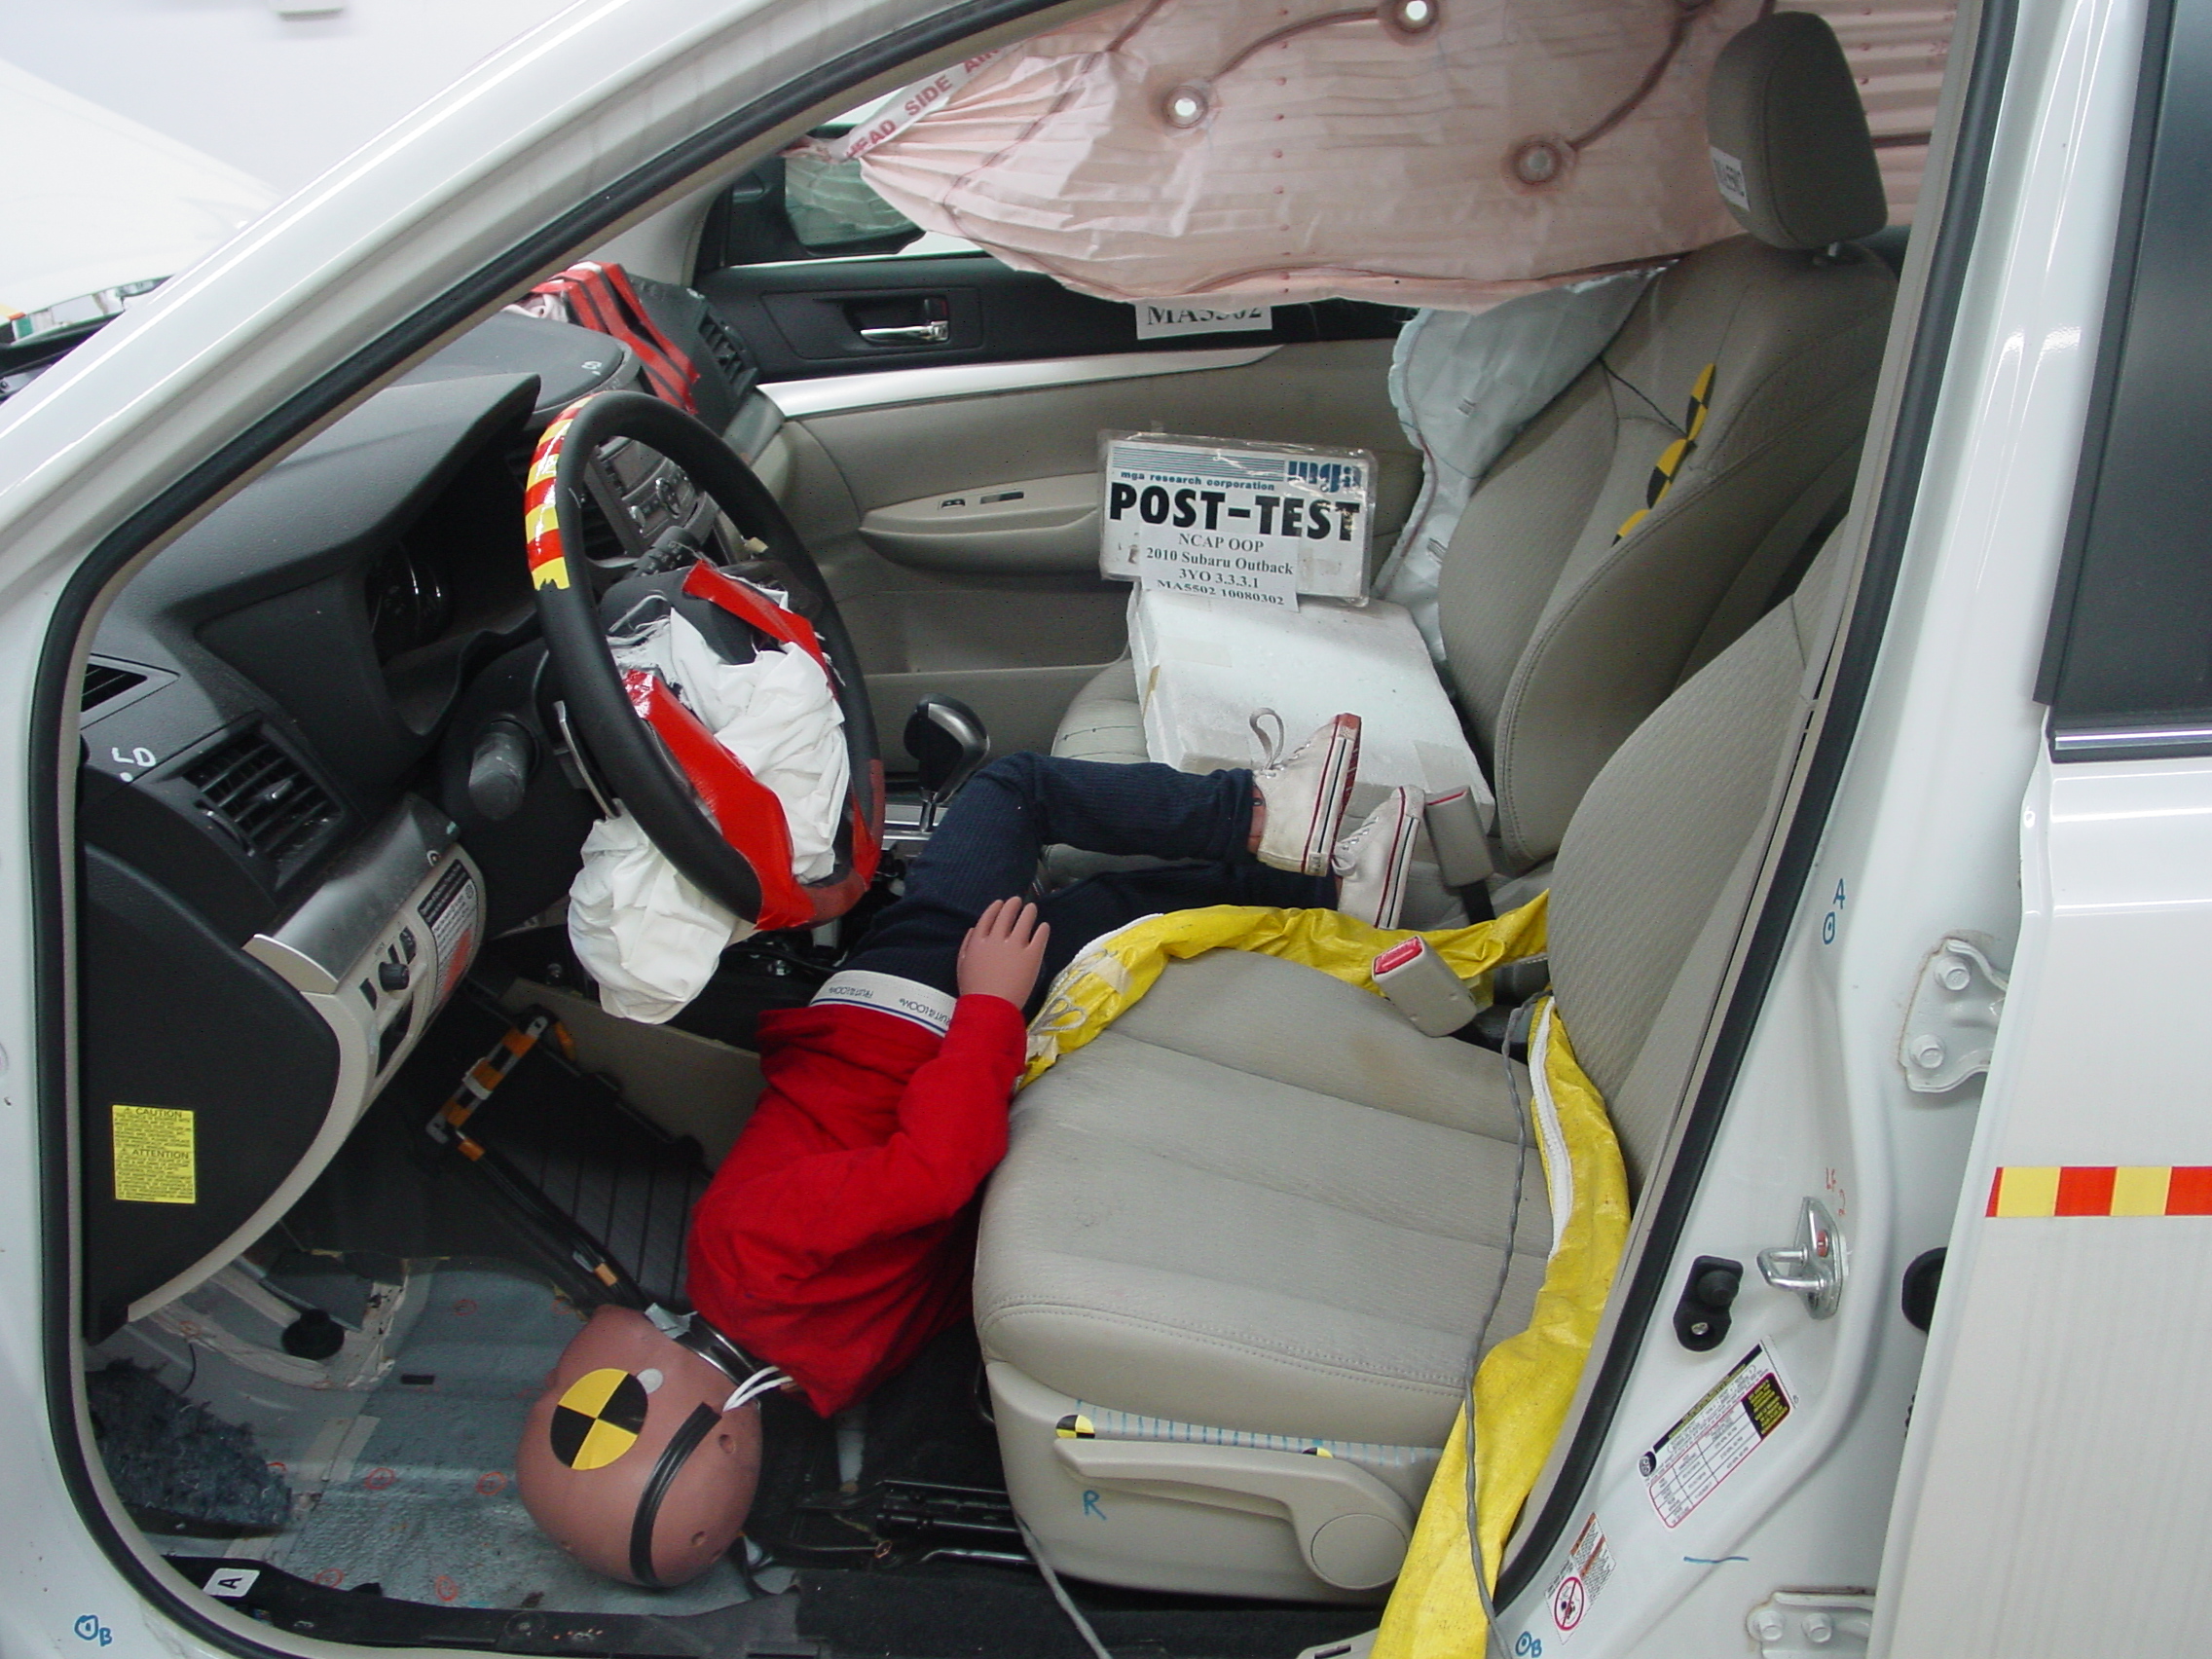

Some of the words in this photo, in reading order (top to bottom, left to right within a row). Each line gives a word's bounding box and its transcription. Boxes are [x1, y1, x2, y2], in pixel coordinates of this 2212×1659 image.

[904, 75, 952, 116] SIDE
[1121, 471, 1145, 480] mga
[1150, 474, 1201, 485] research
[1206, 478, 1275, 491] corporation
[1110, 482, 1360, 541] POST-TEST
[1178, 533, 1224, 548] NCAP
[1228, 537, 1265, 553] OOP
[1146, 547, 1178, 561] 2010
[1181, 551, 1231, 568] Subaru
[1235, 557, 1294, 574] Outback
[1179, 569, 1211, 582] 3YO
[1215, 572, 1259, 589] 3.3.3.1
[1157, 579, 1216, 595] MA5502
[1221, 588, 1285, 606] 10080302
[1832, 878, 1846, 910] A
[135, 1108, 182, 1119] CAUTION
[132, 1149, 189, 1160] ATTENTION
[1083, 1490, 1107, 1521] R
[217, 1576, 242, 1590] A
[99, 1627, 113, 1647] B
[1530, 1639, 1542, 1658] B
